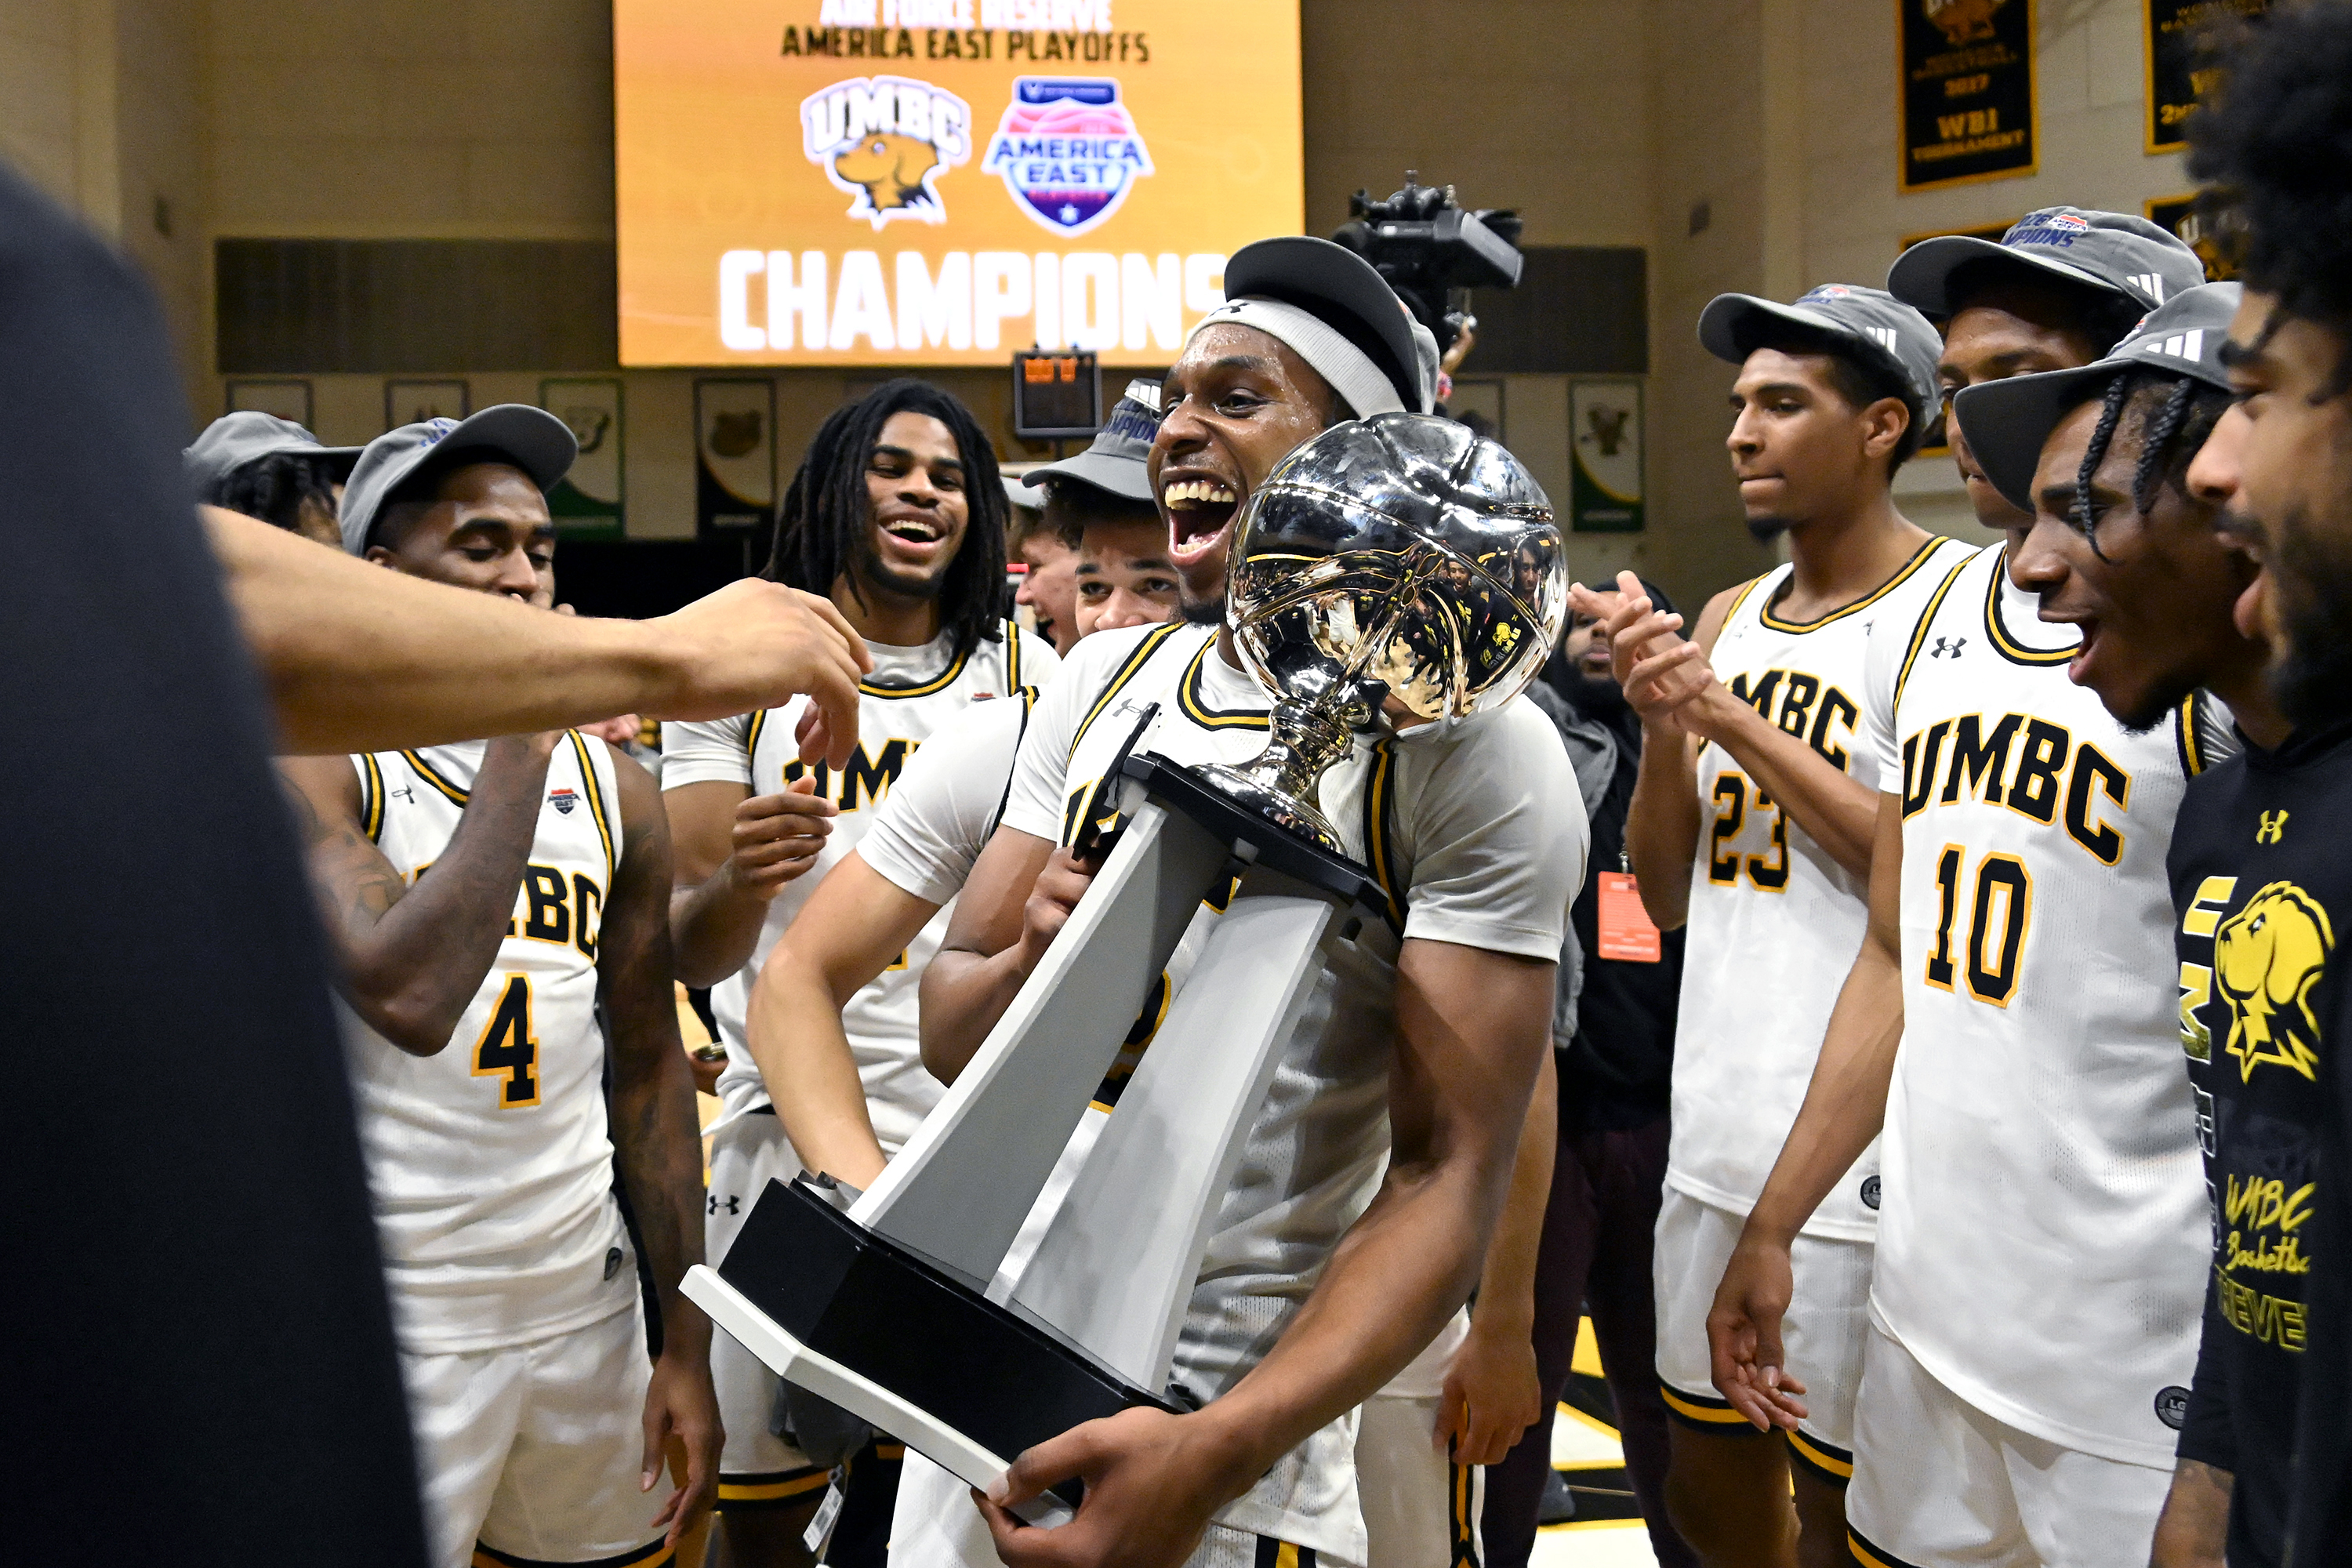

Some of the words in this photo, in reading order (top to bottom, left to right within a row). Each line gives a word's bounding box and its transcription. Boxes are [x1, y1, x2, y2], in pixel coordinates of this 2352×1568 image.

[781, 25, 916, 59] AMERICA
[926, 28, 993, 60] EAST
[1007, 29, 1150, 63] PLAYOFFS
[808, 81, 964, 156] UMBC
[993, 138, 1143, 166] AMERICA
[1937, 107, 1999, 140] WBI
[1027, 163, 1107, 183] EAST
[719, 250, 1229, 351] CHAMPIONS
[1697, 668, 1863, 774] MBC
[1708, 770, 1792, 894] 23
[1901, 711, 2132, 867] UMBC
[1924, 842, 2034, 1010] 10
[470, 971, 541, 1110] 4
